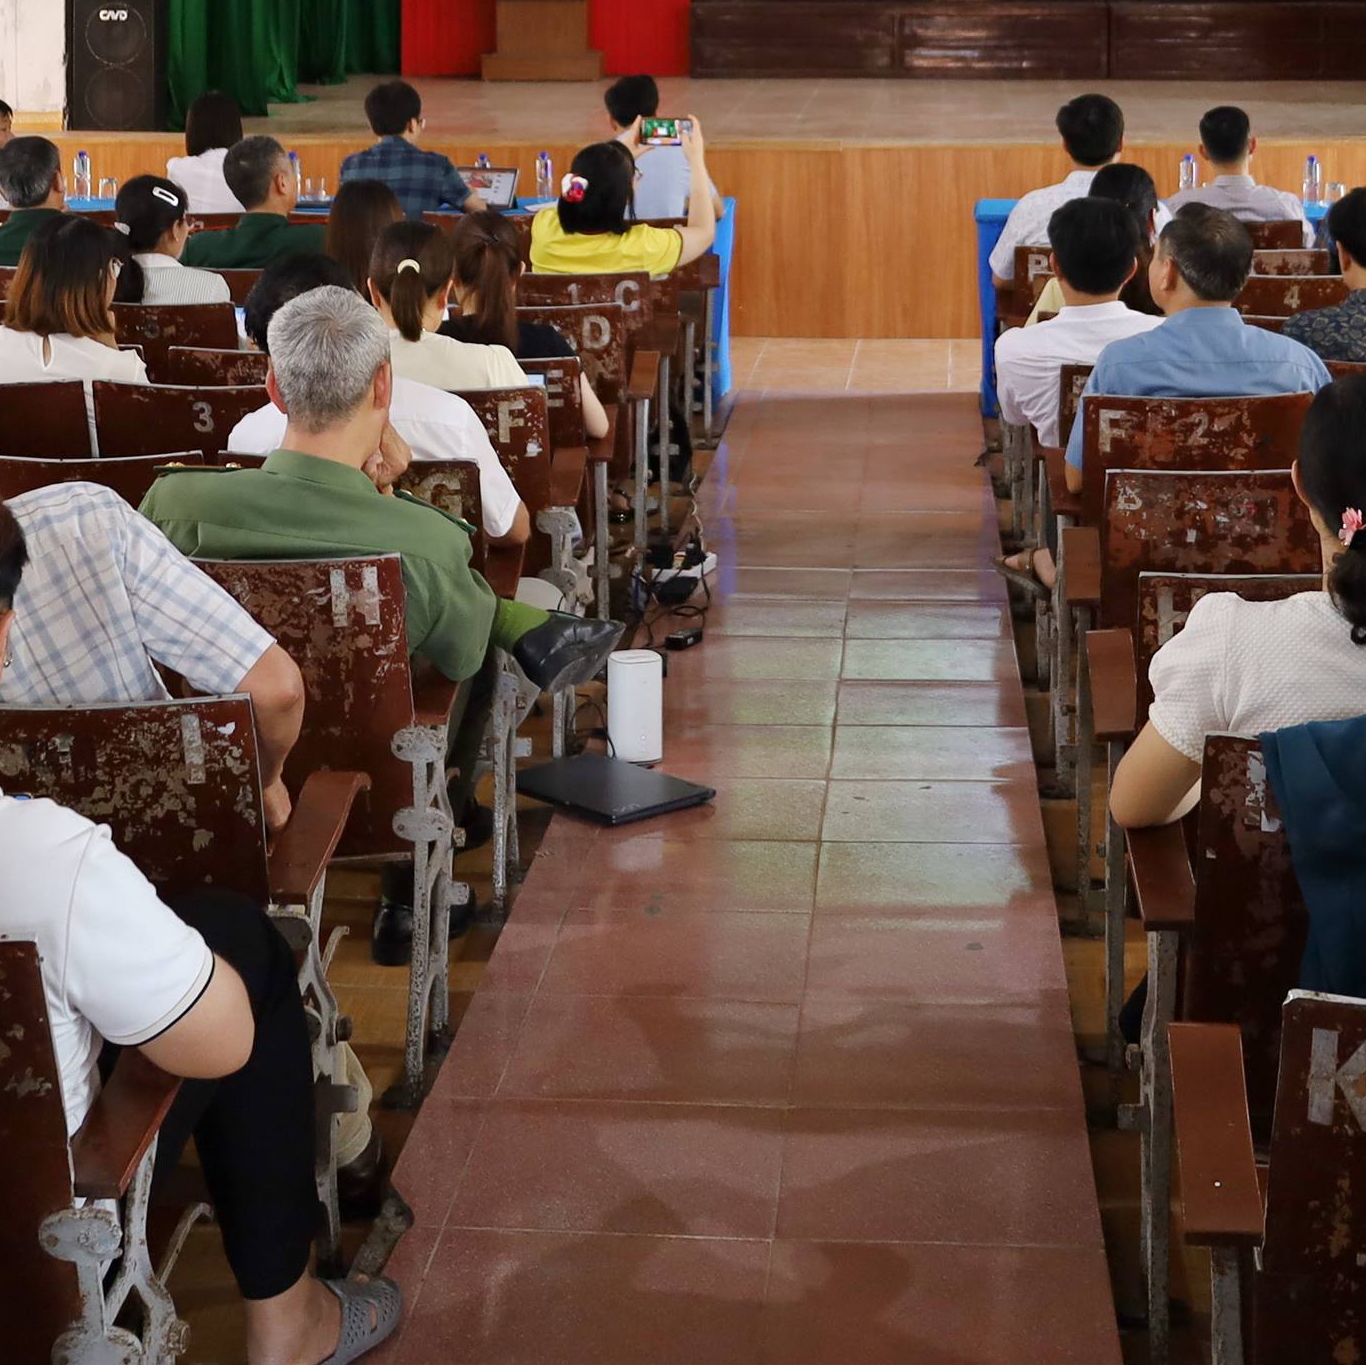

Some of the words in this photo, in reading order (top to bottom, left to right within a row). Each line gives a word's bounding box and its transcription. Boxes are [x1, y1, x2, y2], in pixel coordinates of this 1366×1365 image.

[582, 316, 610, 348] D
[193, 402, 214, 432] 3
[328, 564, 383, 628] H
